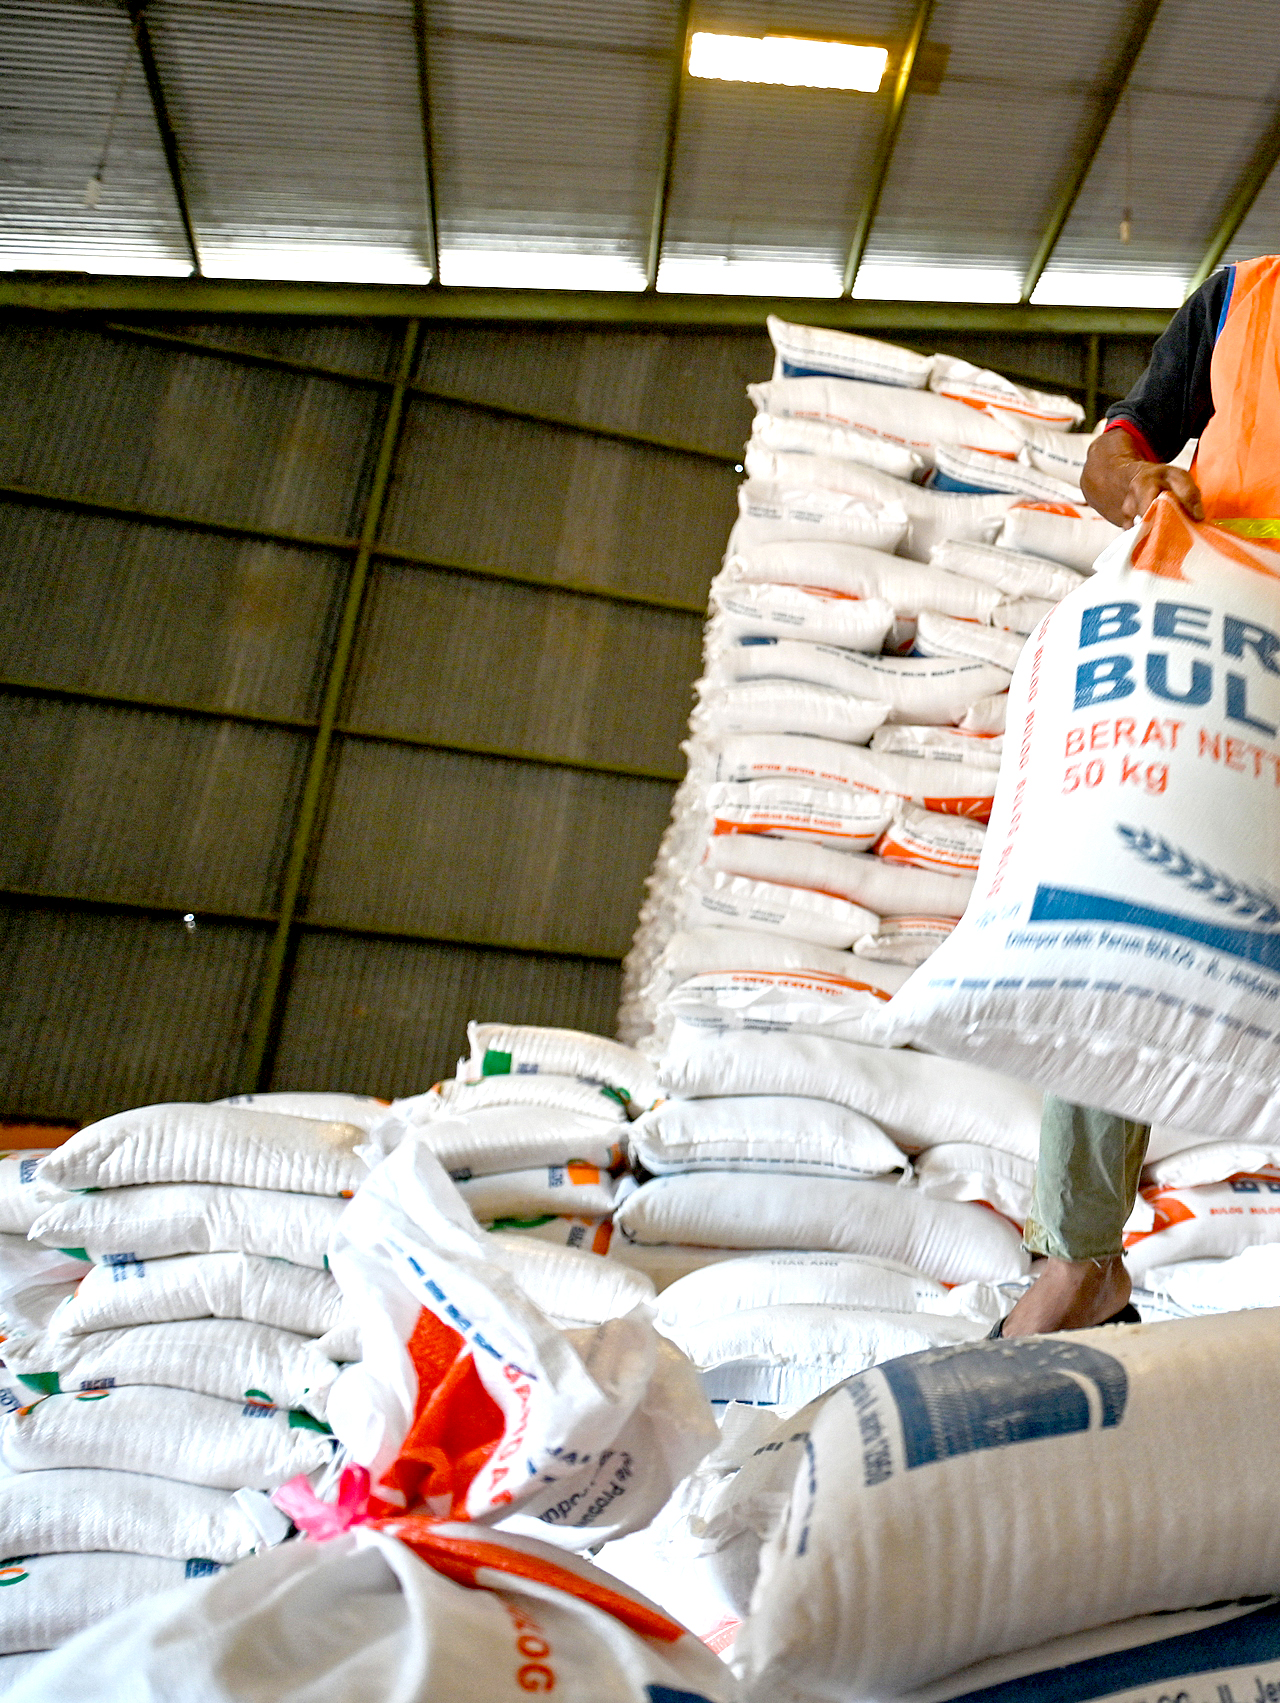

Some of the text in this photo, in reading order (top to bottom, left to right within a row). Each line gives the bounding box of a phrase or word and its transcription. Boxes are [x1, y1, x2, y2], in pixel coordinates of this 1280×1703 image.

[1064, 715, 1186, 760] BERAT
[1061, 753, 1171, 797] 50 kg
